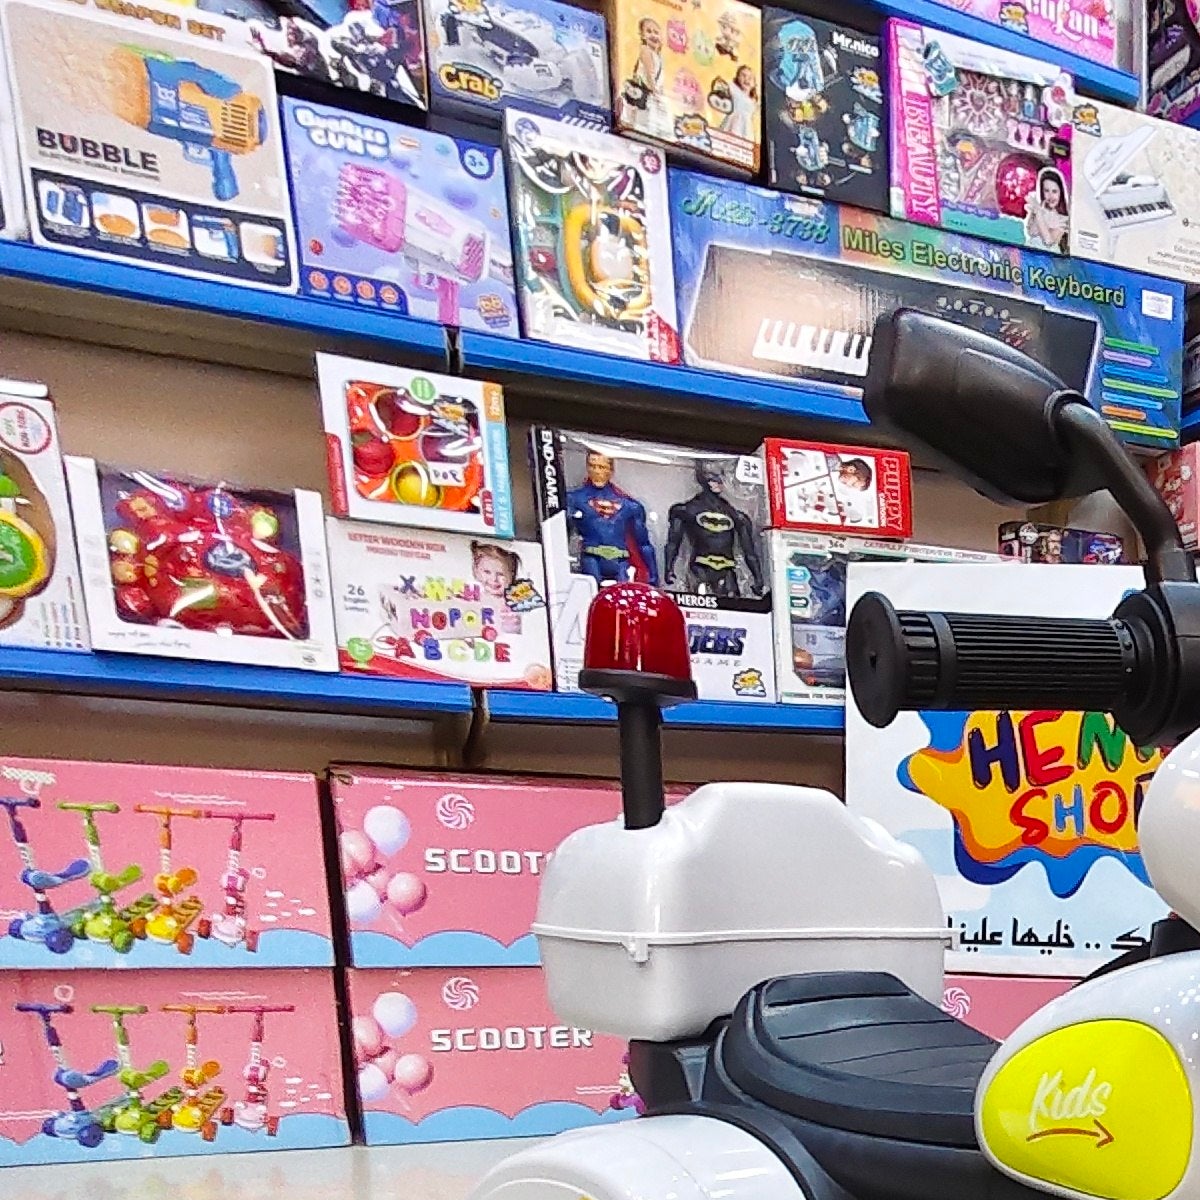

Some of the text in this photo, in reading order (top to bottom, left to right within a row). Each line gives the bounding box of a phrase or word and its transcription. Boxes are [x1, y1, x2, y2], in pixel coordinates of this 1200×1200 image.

[438, 64, 501, 100] Crab
[36, 126, 160, 174] BUBBLE
[842, 225, 905, 260] Miles
[911, 240, 1024, 286] Electronic
[1028, 265, 1126, 309] Keyboard
[541, 429, 559, 509] END-GAME
[882, 456, 903, 531] PUPPY
[347, 584, 365, 596] 26
[679, 592, 719, 609] HEROES
[968, 710, 1170, 793] HEM
[424, 847, 553, 875] SCOOT
[430, 1025, 594, 1052] SCOOTER
[1028, 1066, 1113, 1131] Kids
